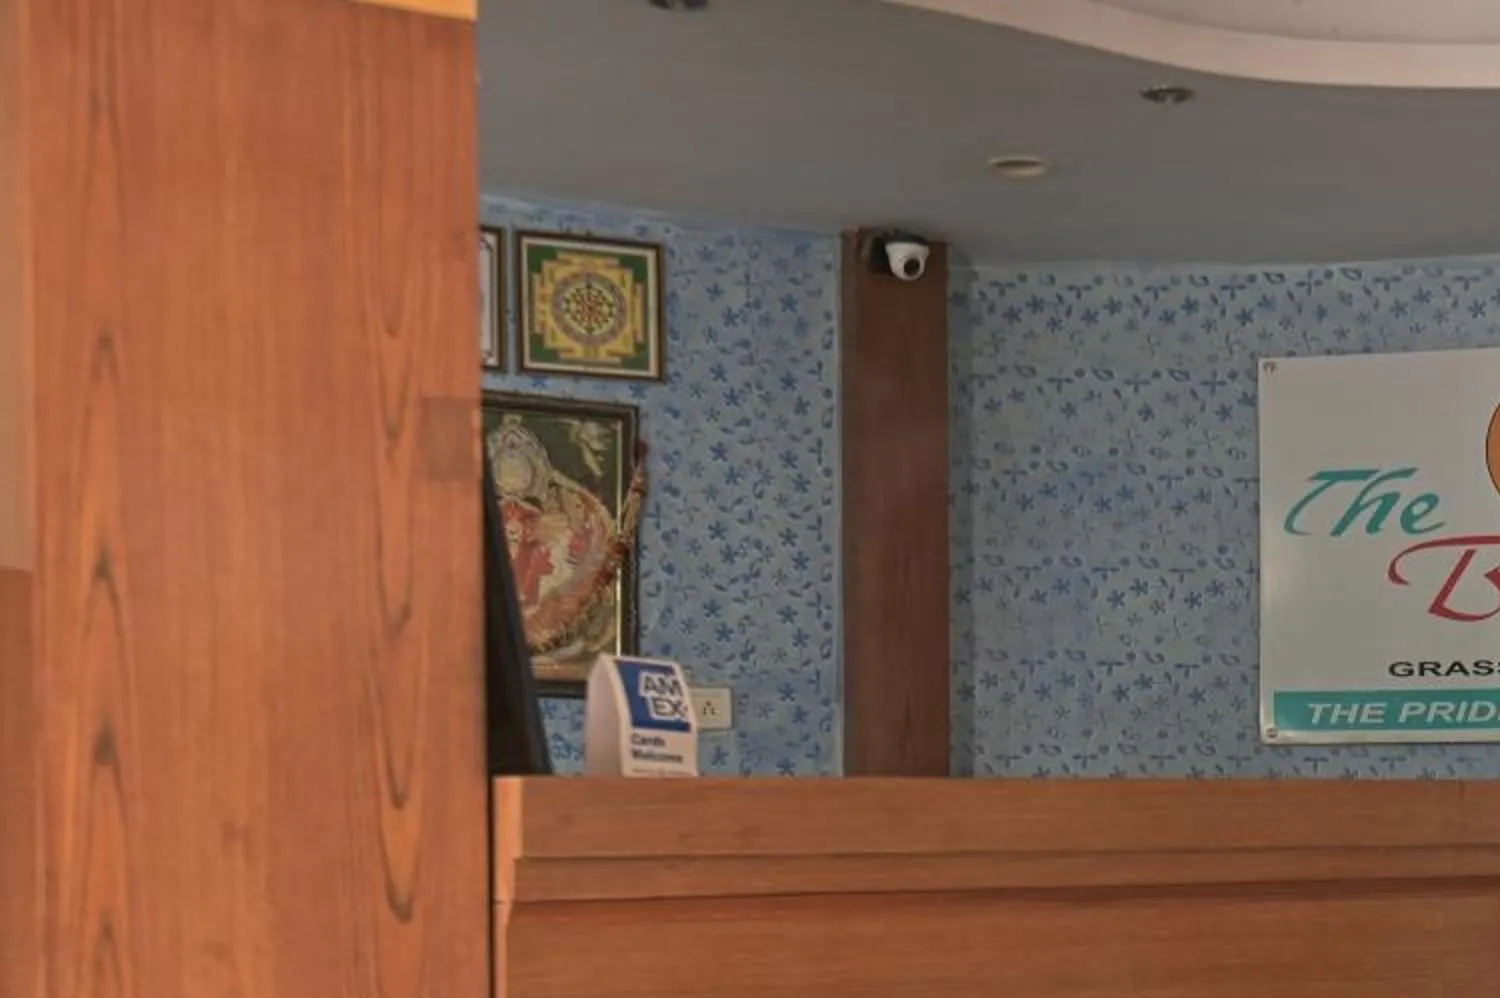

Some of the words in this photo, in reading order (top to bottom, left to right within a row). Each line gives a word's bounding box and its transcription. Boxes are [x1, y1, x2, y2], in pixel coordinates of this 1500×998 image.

[1284, 467, 1446, 537] The
[644, 675, 684, 697] AM
[652, 698, 686, 717] EX
[1307, 702, 1387, 725] THE
